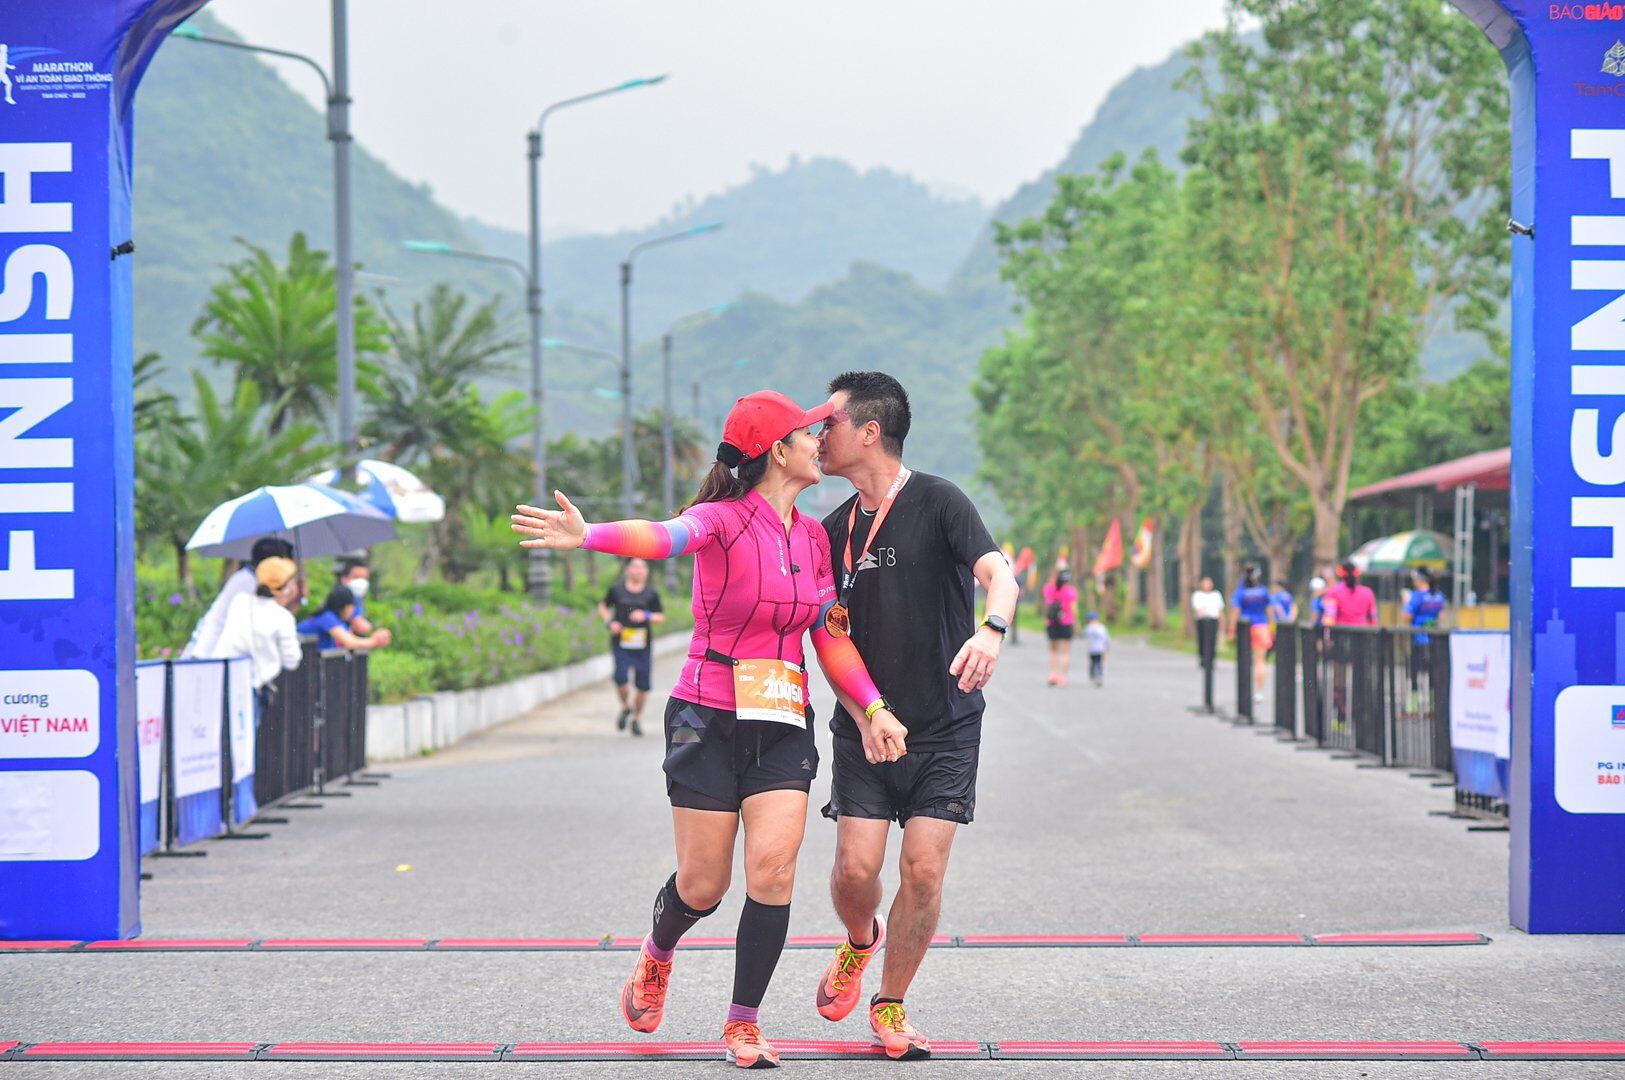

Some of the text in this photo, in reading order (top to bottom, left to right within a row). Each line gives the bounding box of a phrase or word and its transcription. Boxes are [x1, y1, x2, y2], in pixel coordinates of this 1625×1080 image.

[33, 62, 94, 73] MARATHON
[25, 75, 39, 83] AN
[62, 73, 84, 82] GIAO
[0, 142, 75, 600] FINISH
[4, 693, 49, 708] cương
[0, 714, 88, 737] VIỆT NAM
[1598, 762, 1614, 770] PG
